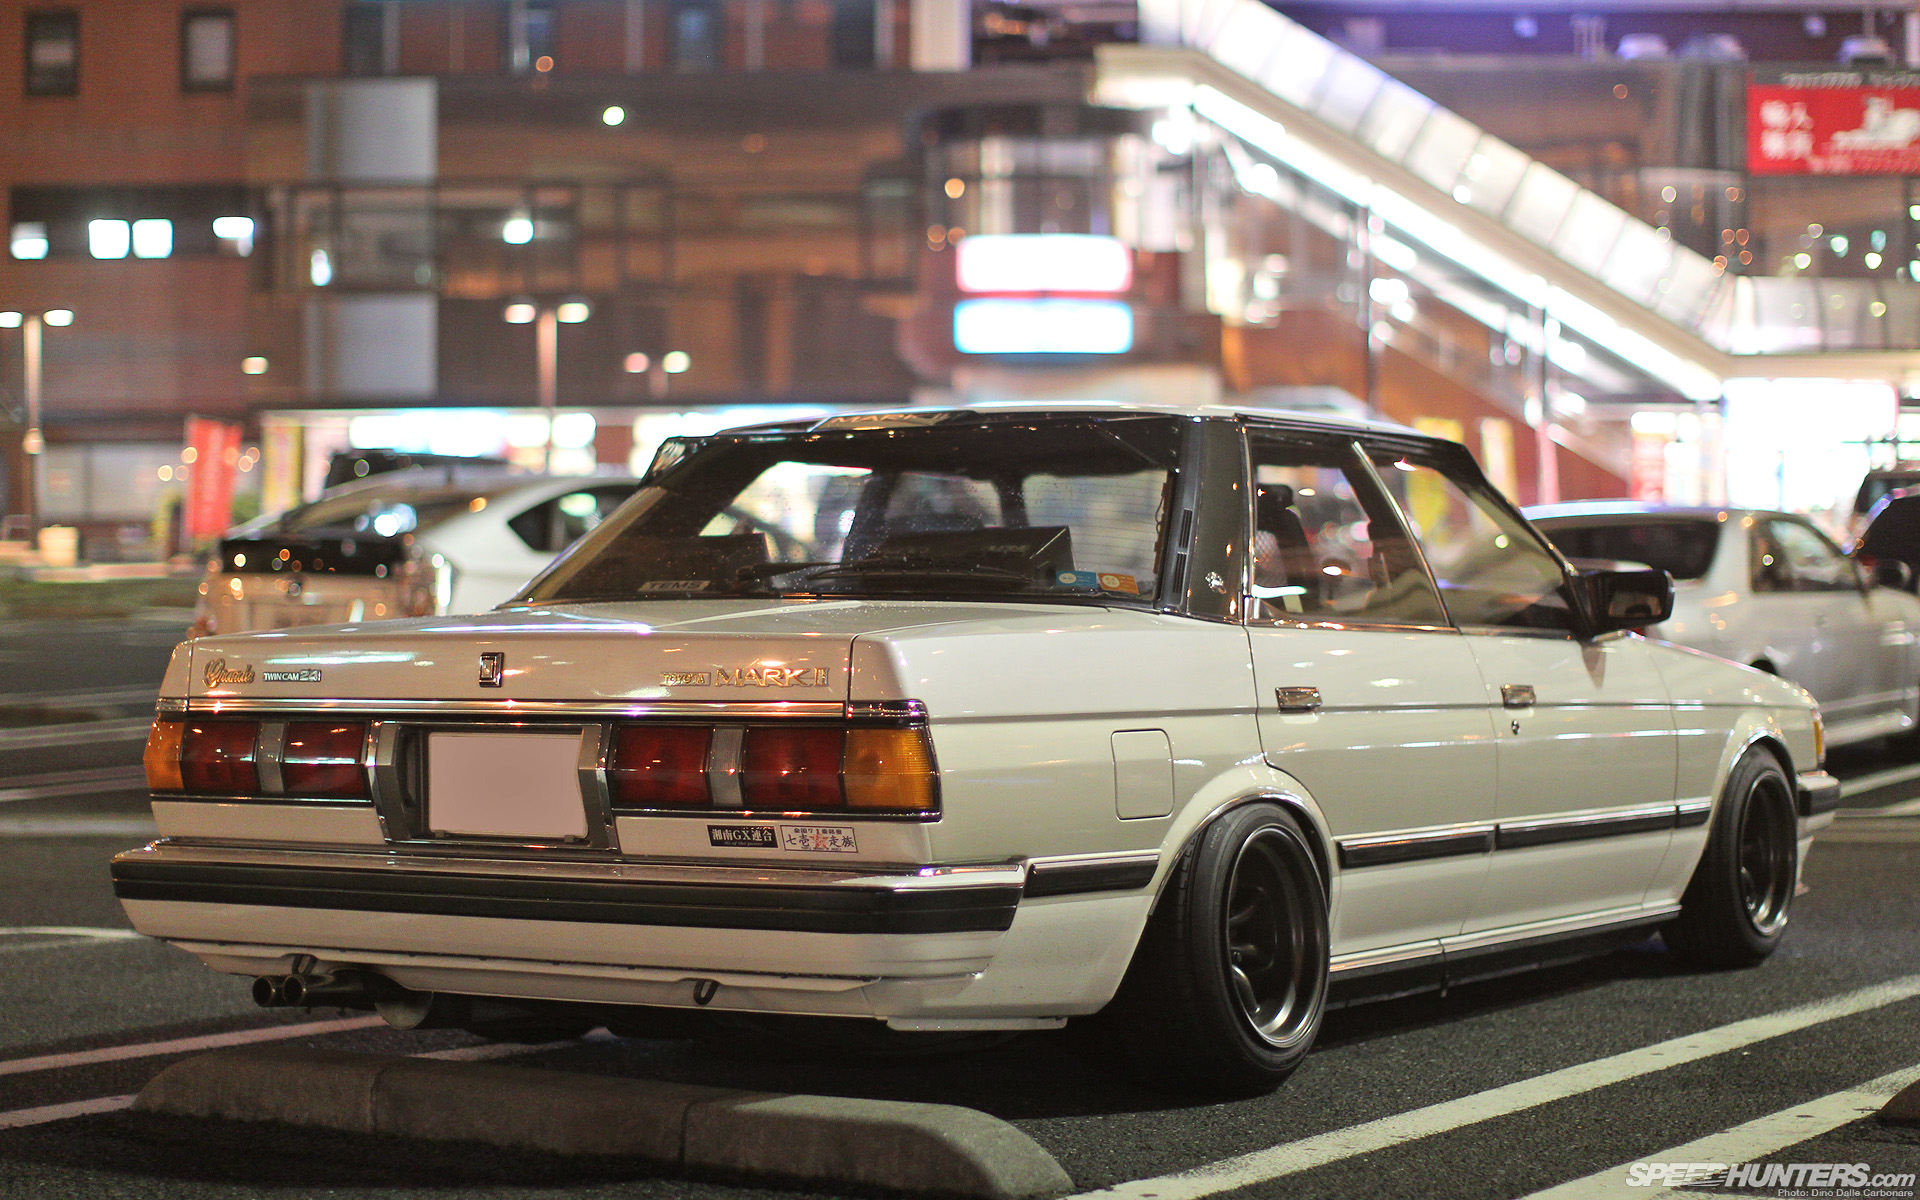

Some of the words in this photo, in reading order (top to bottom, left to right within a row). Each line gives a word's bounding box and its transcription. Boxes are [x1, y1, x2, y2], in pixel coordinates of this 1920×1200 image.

[202, 658, 256, 688] Grande
[662, 672, 706, 686] TOYOTA
[715, 667, 809, 688] MARK
[712, 827, 773, 842] 湘南GX連合
